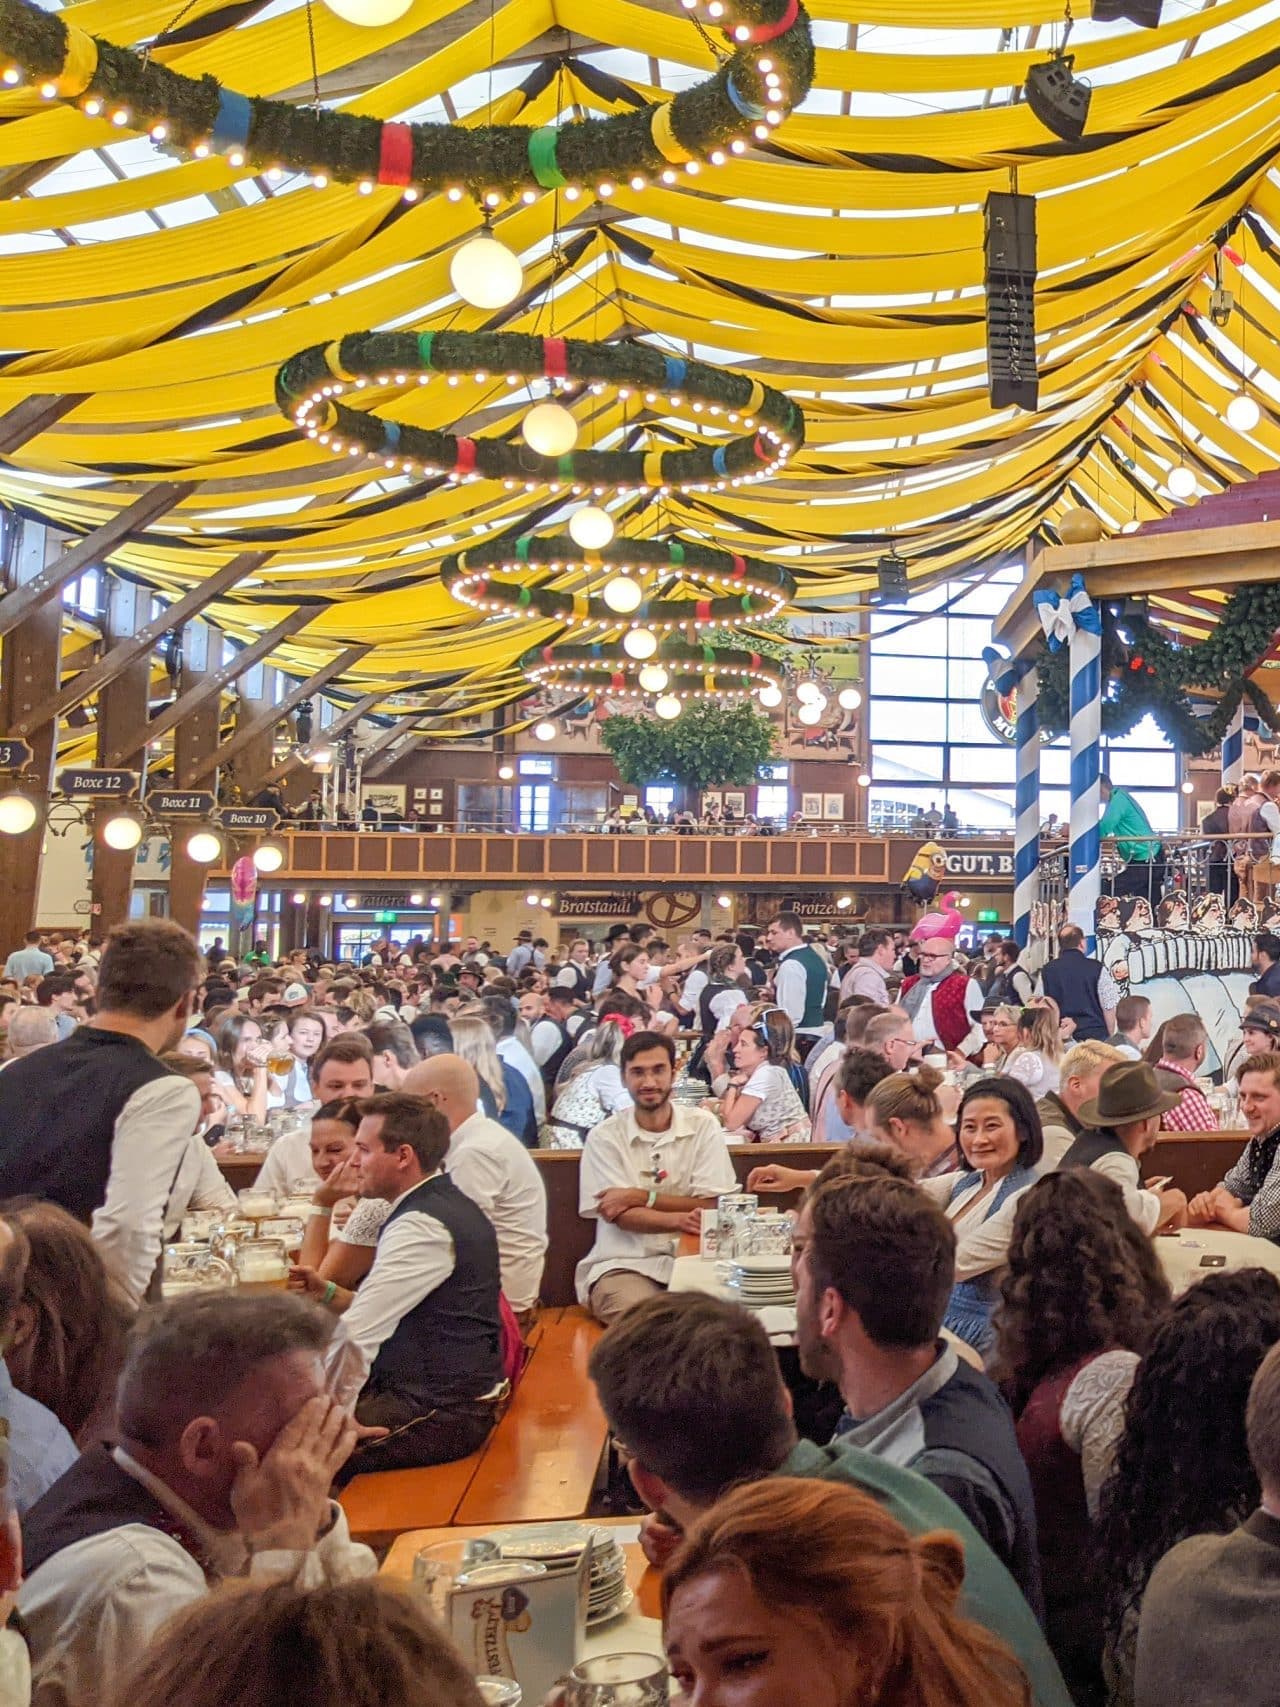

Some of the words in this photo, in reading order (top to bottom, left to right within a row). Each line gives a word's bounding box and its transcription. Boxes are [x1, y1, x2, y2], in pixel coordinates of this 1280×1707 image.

[73, 776, 104, 789] Boxe
[105, 776, 121, 789] 12
[161, 797, 186, 808] Boxe
[188, 797, 201, 808] 11
[230, 813, 253, 824] Boxe
[255, 814, 267, 824] 10
[945, 854, 996, 876] GUT,
[998, 854, 1015, 873] B
